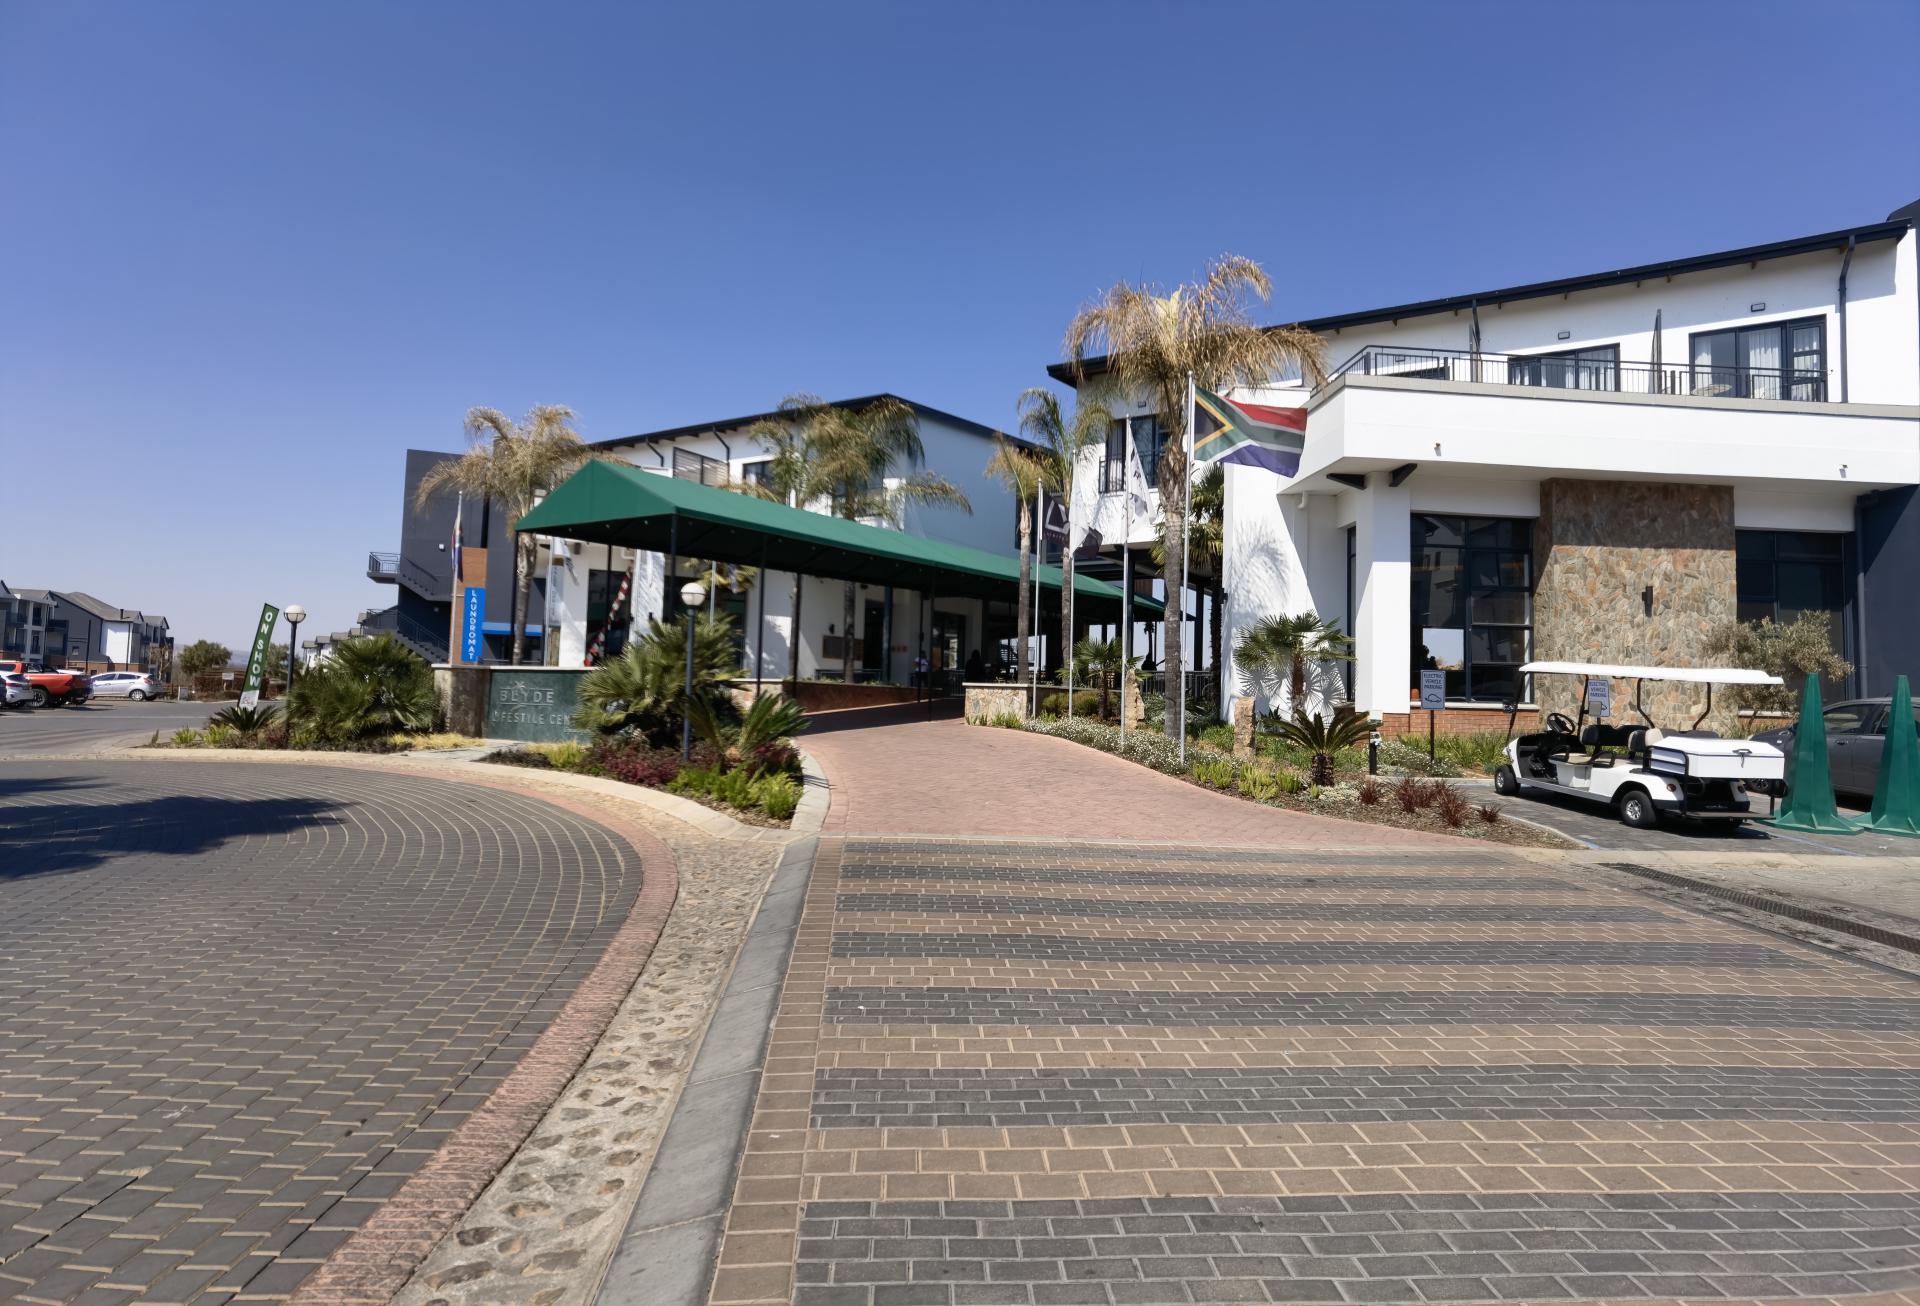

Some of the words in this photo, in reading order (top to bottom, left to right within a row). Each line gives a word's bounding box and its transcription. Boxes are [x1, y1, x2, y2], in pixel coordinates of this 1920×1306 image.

[261, 612, 273, 635] ON
[468, 589, 477, 660] LAUNDROMAT
[249, 639, 264, 687] SHOW
[500, 690, 554, 703] BLYDE
